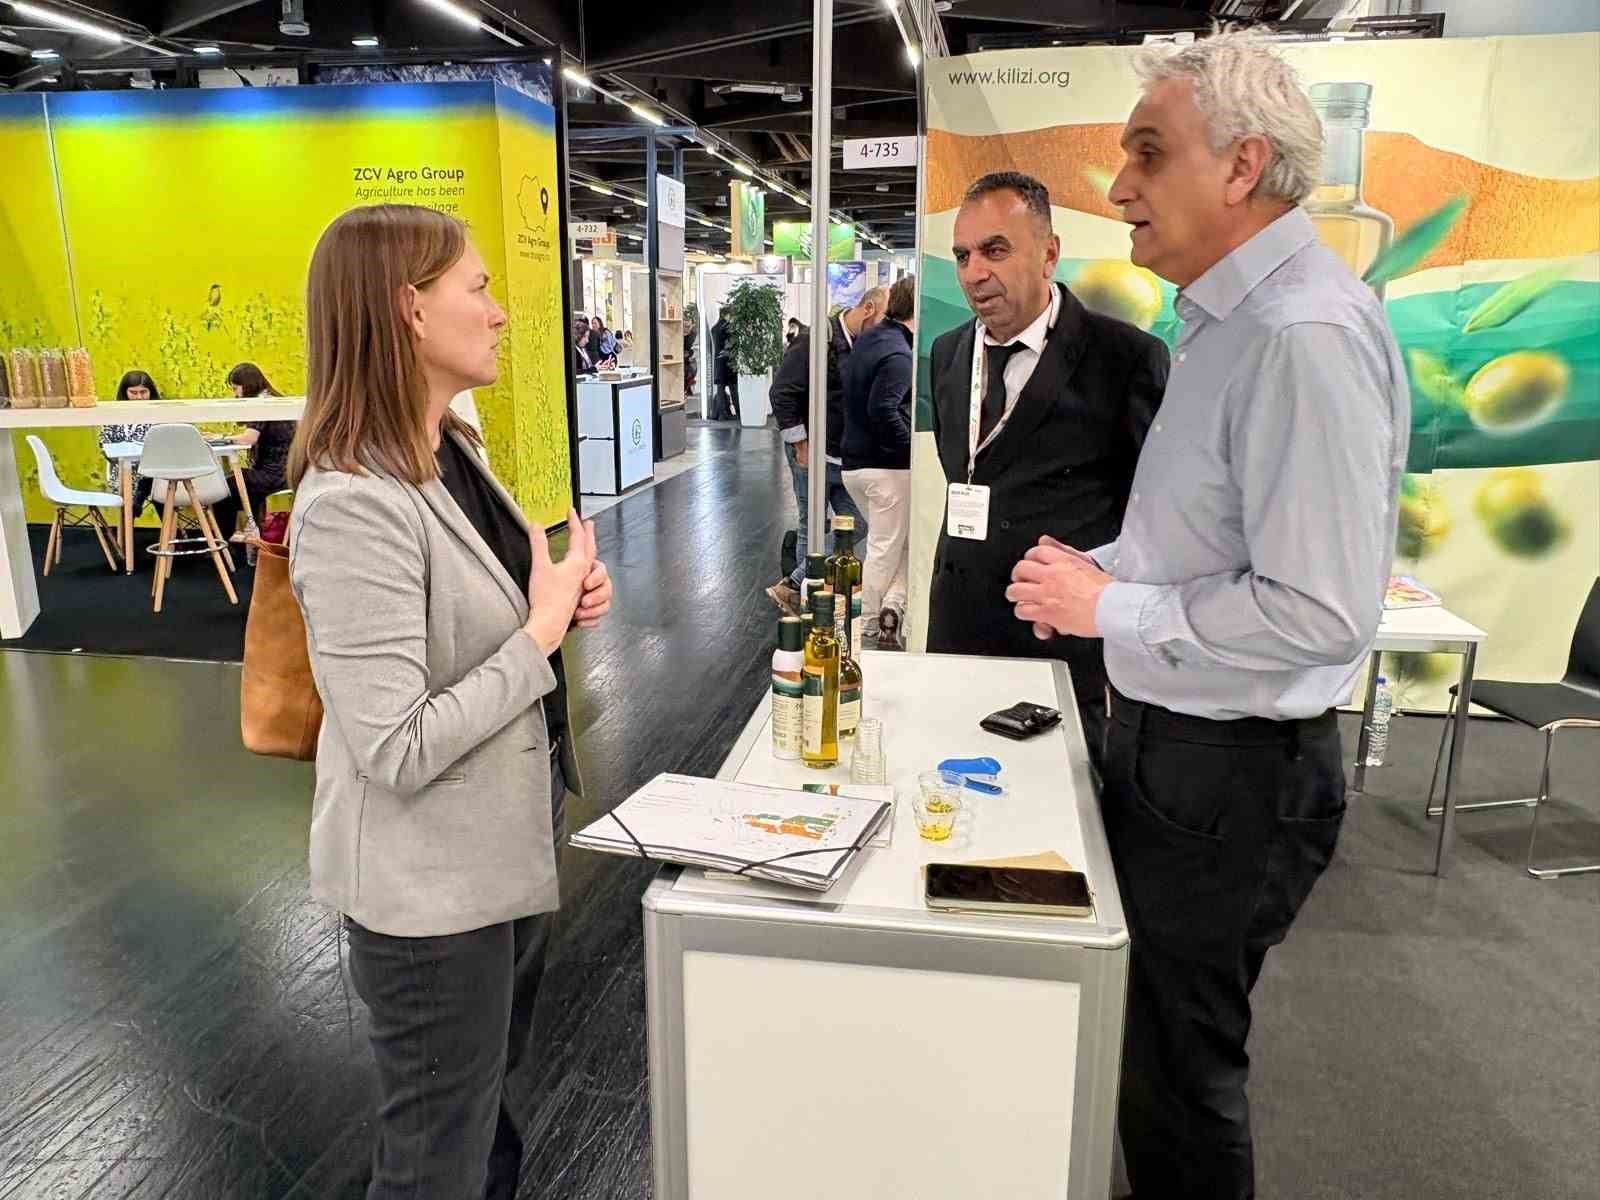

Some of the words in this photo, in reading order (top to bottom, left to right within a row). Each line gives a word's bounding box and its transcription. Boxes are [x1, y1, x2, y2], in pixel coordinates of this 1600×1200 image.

[948, 67, 1070, 88] www.kilizi.org
[860, 142, 899, 158] 4-735
[353, 168, 382, 181] ZCV
[386, 168, 418, 184] Agro
[421, 166, 465, 182] Group
[355, 186, 413, 200] Agriculture
[416, 185, 437, 197] has
[439, 185, 465, 197] been
